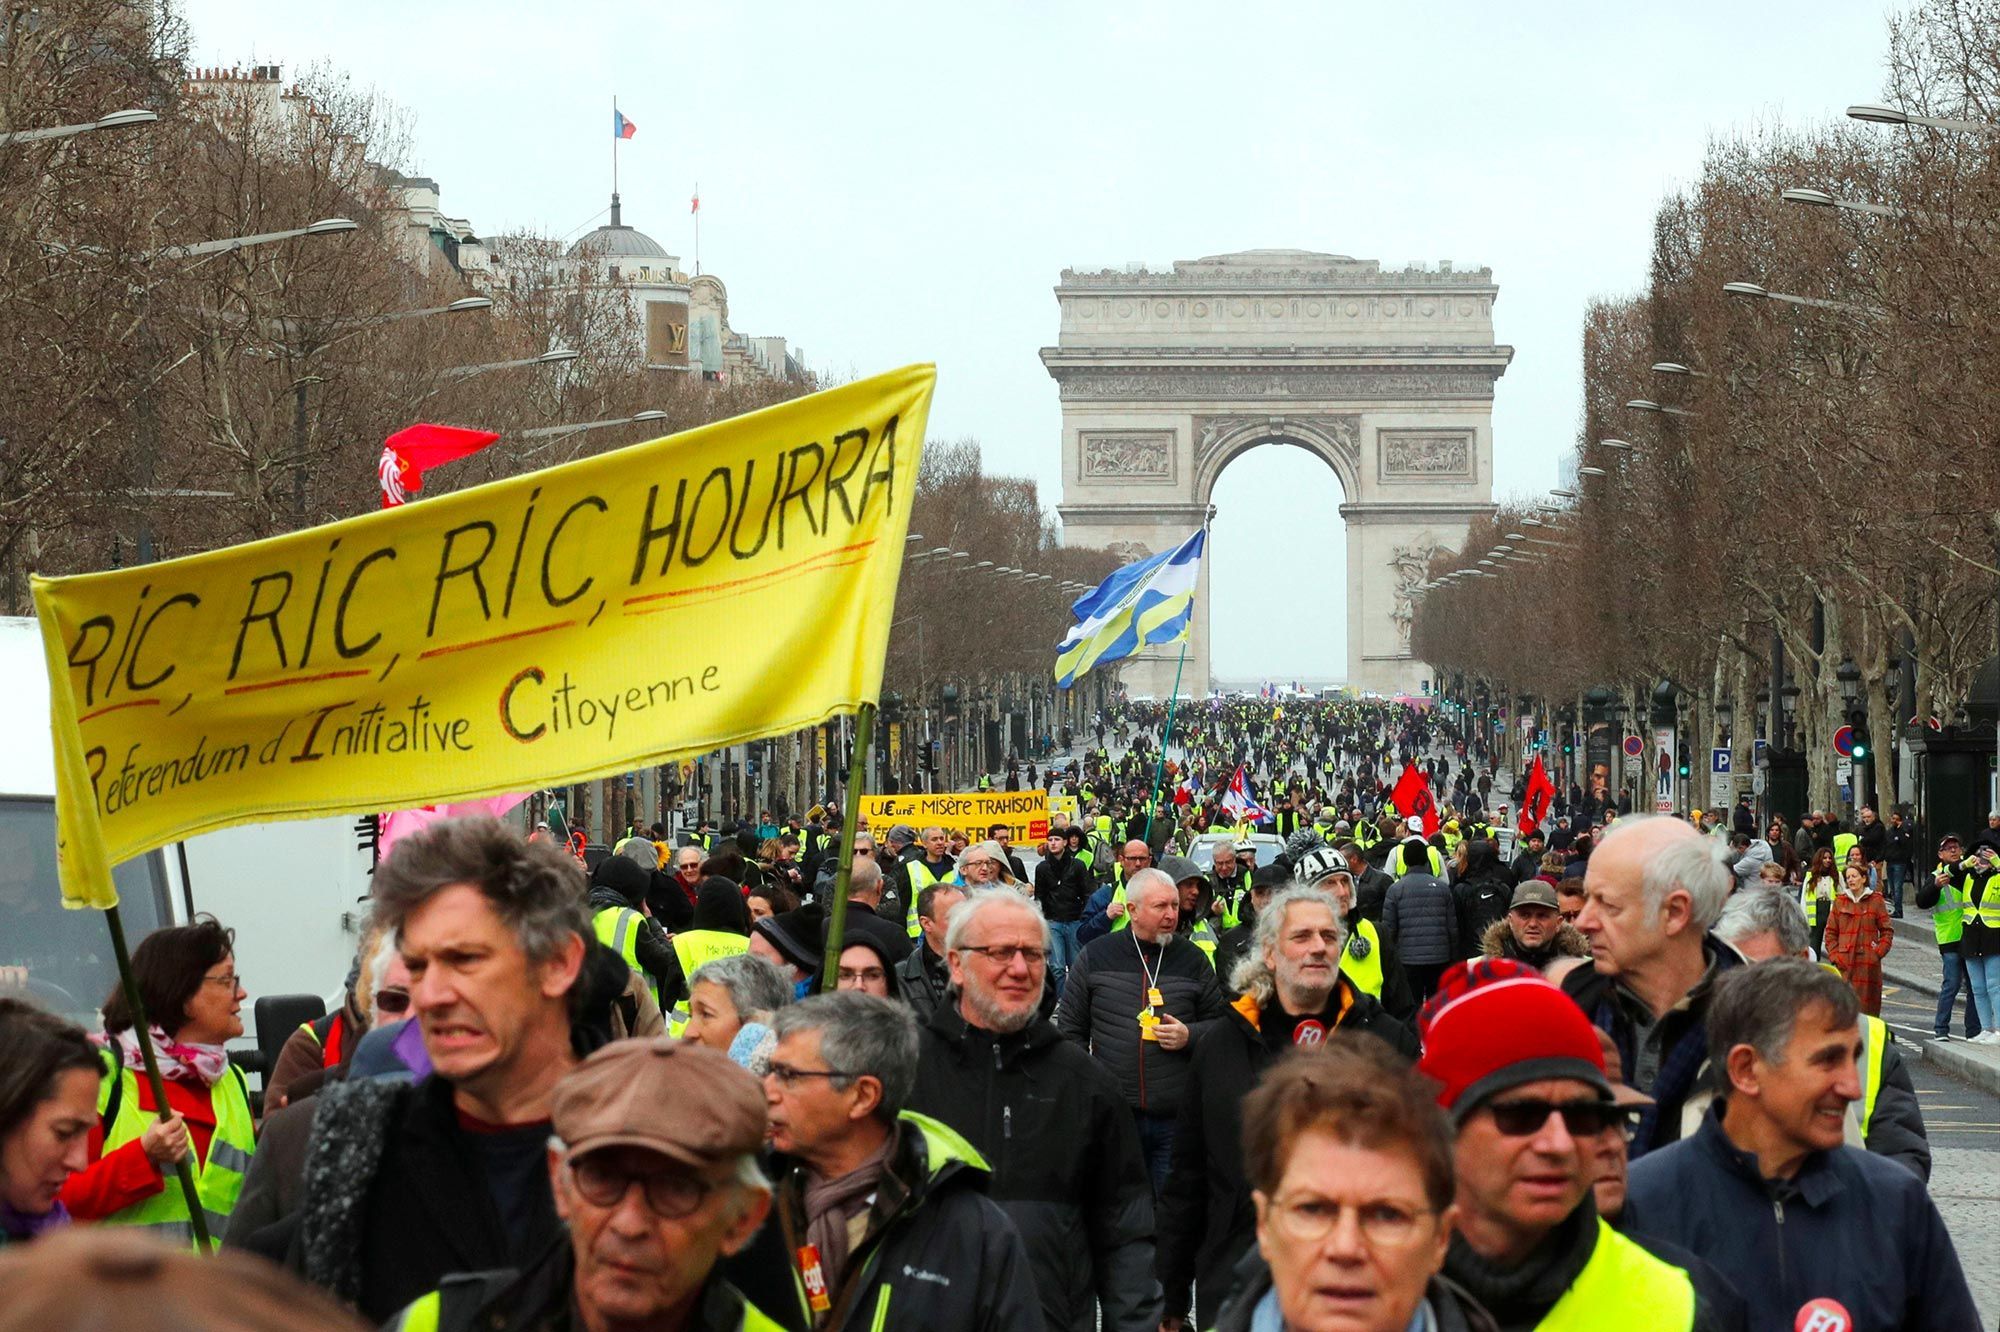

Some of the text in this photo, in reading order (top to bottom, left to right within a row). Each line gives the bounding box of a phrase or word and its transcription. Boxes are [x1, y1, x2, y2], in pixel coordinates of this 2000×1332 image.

[630, 414, 899, 586] HOURRA
[499, 666, 720, 743] Citoyenne
[1718, 754, 1730, 769] P
